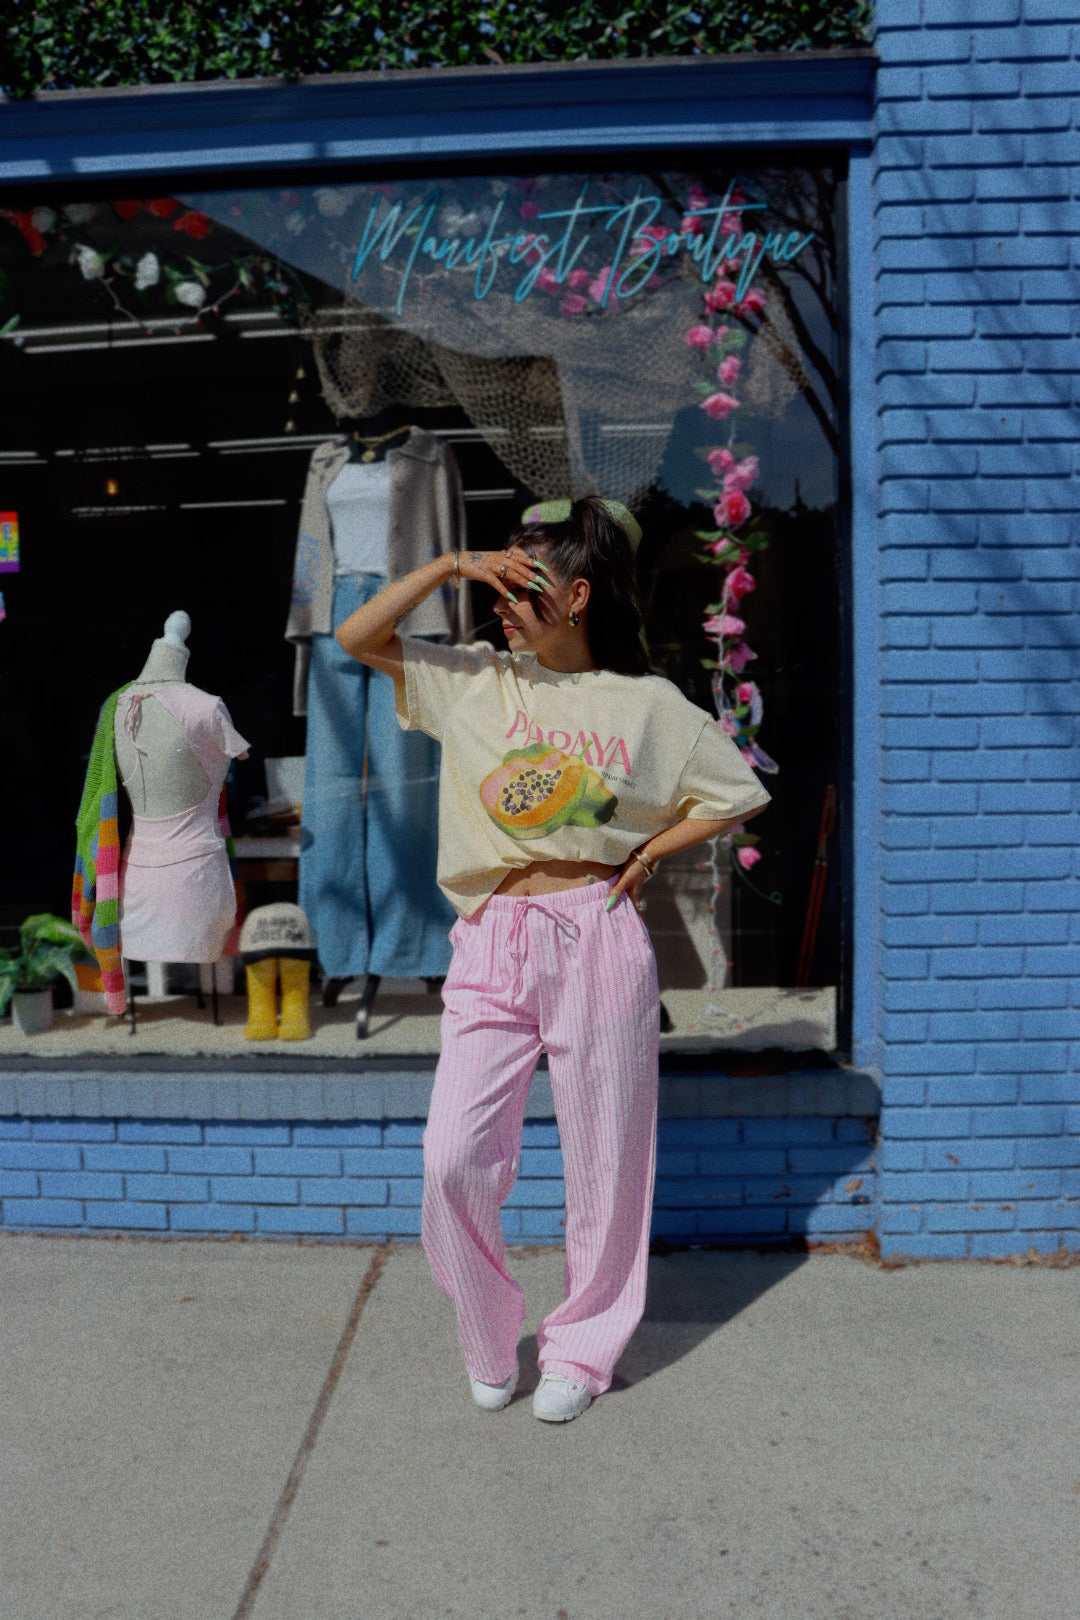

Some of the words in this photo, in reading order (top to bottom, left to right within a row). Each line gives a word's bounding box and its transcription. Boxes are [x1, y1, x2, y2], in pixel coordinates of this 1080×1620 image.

[351, 182, 621, 315] Manifest
[601, 180, 815, 308] Boutique
[505, 710, 632, 777] PAPAYA
